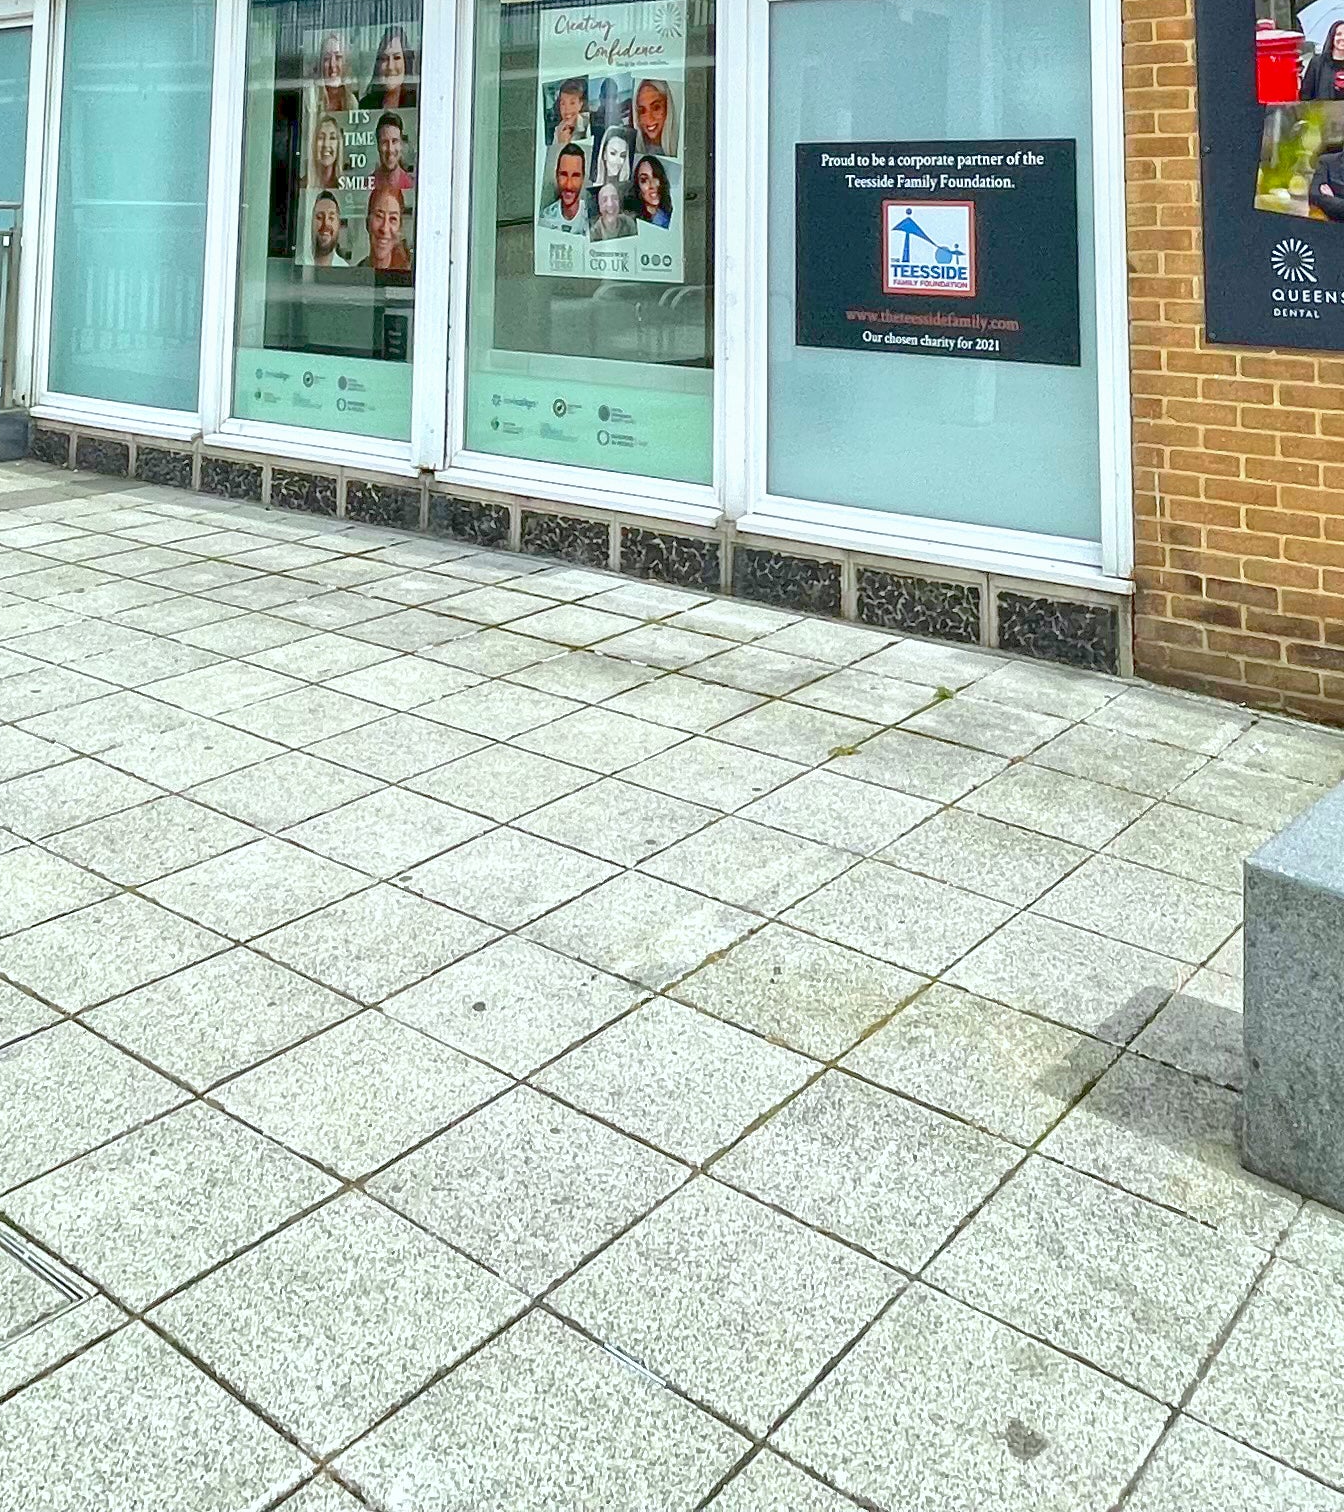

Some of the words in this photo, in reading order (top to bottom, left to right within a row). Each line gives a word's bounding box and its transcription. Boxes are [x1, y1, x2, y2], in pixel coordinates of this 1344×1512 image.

[554, 14, 615, 41] Creating
[584, 35, 665, 65] Confidence
[348, 109, 370, 125] IT'S
[343, 131, 376, 147] TIME
[349, 153, 367, 169] TO
[821, 153, 855, 167] Proud
[857, 154, 870, 166] to
[871, 153, 886, 166] be
[887, 156, 895, 166] a
[897, 154, 955, 169] corporate
[957, 154, 1004, 169] partner
[1006, 151, 1022, 165] of
[1023, 152, 1044, 165] the
[338, 175, 376, 191] SMILE
[845, 174, 894, 188] Teesside
[897, 174, 938, 191] Family
[940, 174, 1016, 188] Foundation.
[890, 264, 968, 280] TEESSIDE
[920, 279, 968, 288] FOUNDATION
[845, 308, 1020, 332] www.theteessidefamily.com
[1273, 308, 1320, 319] DENTAL
[862, 330, 883, 343] Our
[884, 331, 918, 345] chosen
[920, 334, 956, 351] charity
[957, 337, 974, 350] for
[975, 338, 1000, 351] 2021
